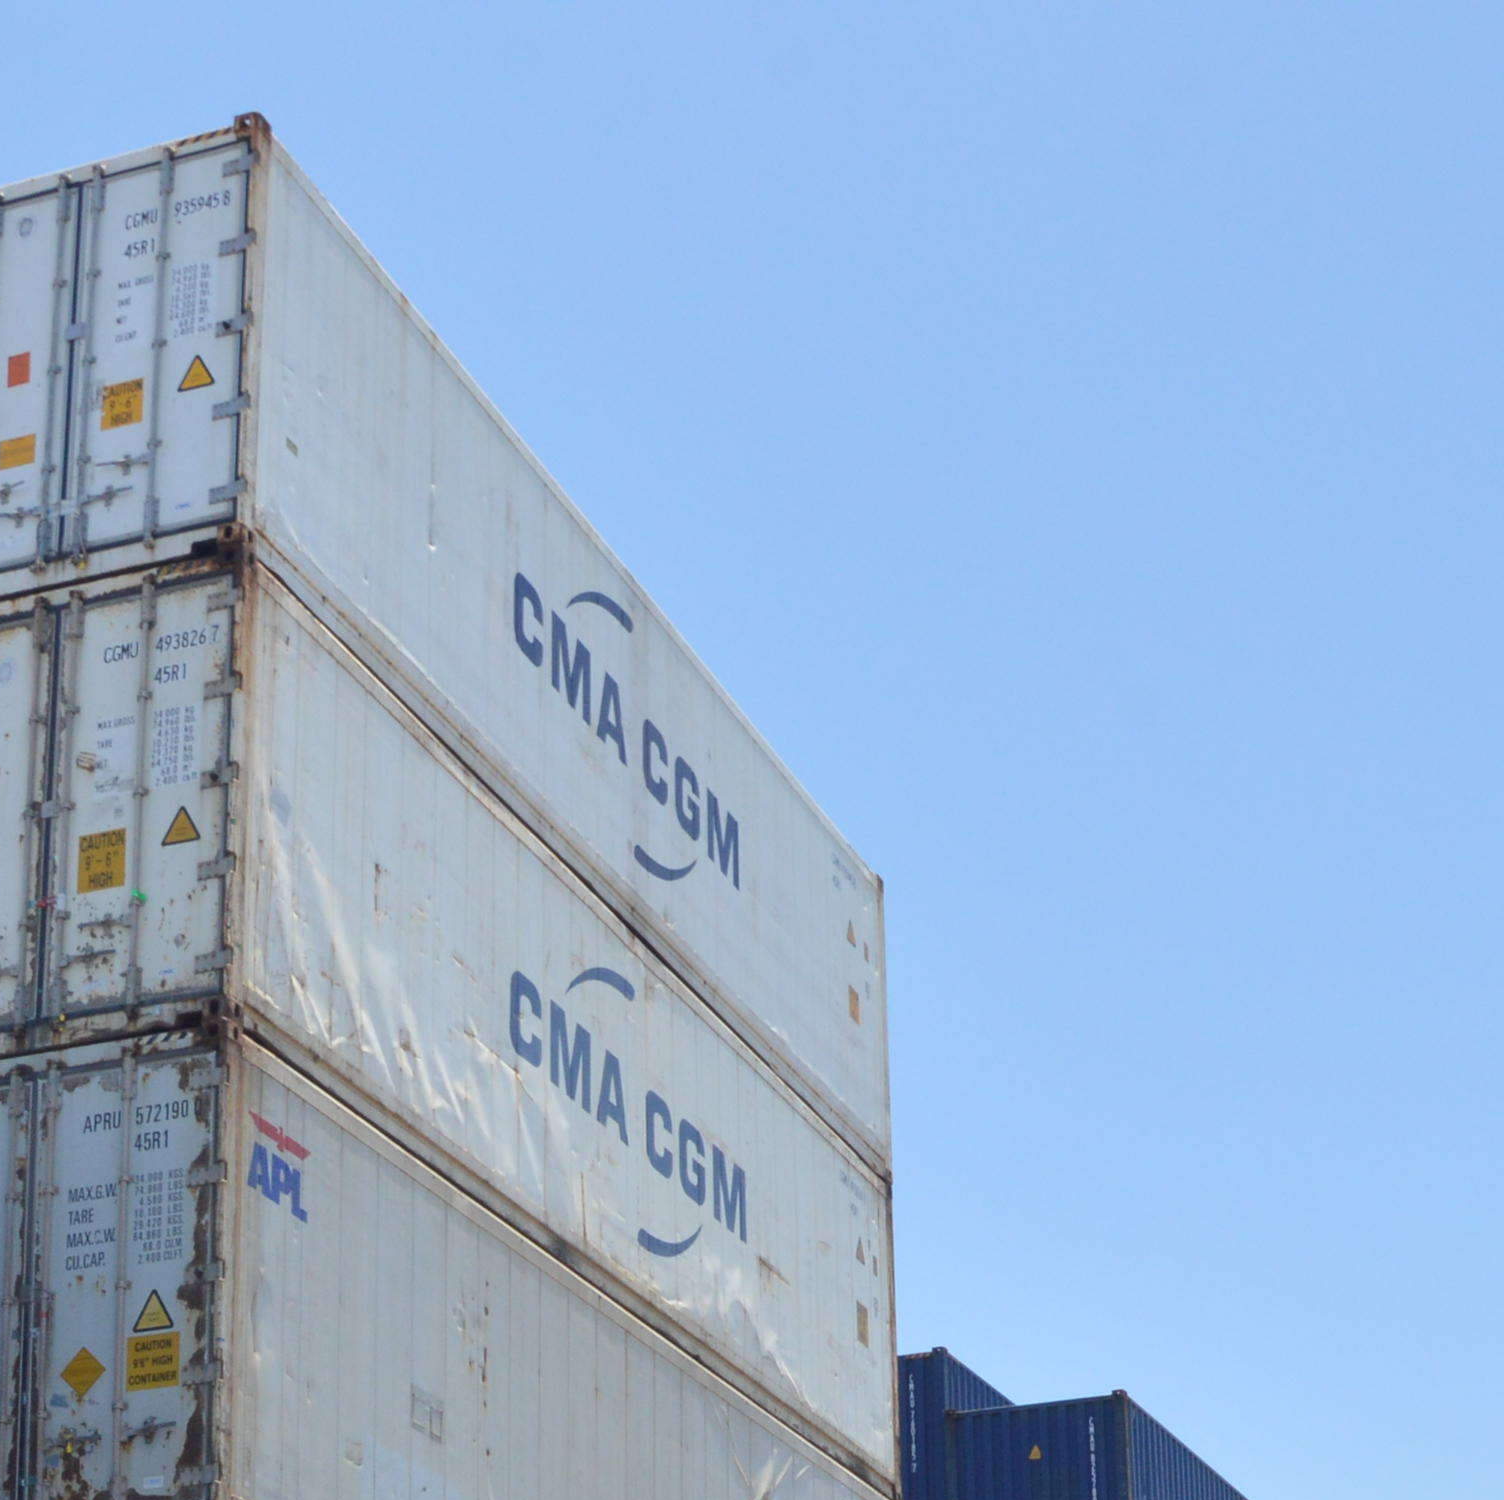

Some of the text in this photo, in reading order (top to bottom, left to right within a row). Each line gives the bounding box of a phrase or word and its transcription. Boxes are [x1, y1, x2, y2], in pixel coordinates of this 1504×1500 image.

[125, 208, 158, 230] CGMU
[124, 238, 155, 258] 45R1
[104, 642, 139, 663] CGMU
[155, 629, 206, 651] 493826
[154, 663, 187, 684] 45R1
[514, 572, 740, 891] CMA CGM
[80, 829, 125, 852] CAUTION
[89, 871, 113, 889] HIGH
[83, 1110, 121, 1134] APRU
[135, 1100, 189, 1125] 572190
[510, 970, 747, 1243] CMA CGM
[135, 1130, 168, 1151] 45R1
[247, 1141, 308, 1223] APL
[68, 1209, 94, 1226] TARE
[135, 1339, 172, 1352] CAUTION
[152, 1354, 173, 1366] HIGH
[129, 1371, 177, 1386] CONTAINER
